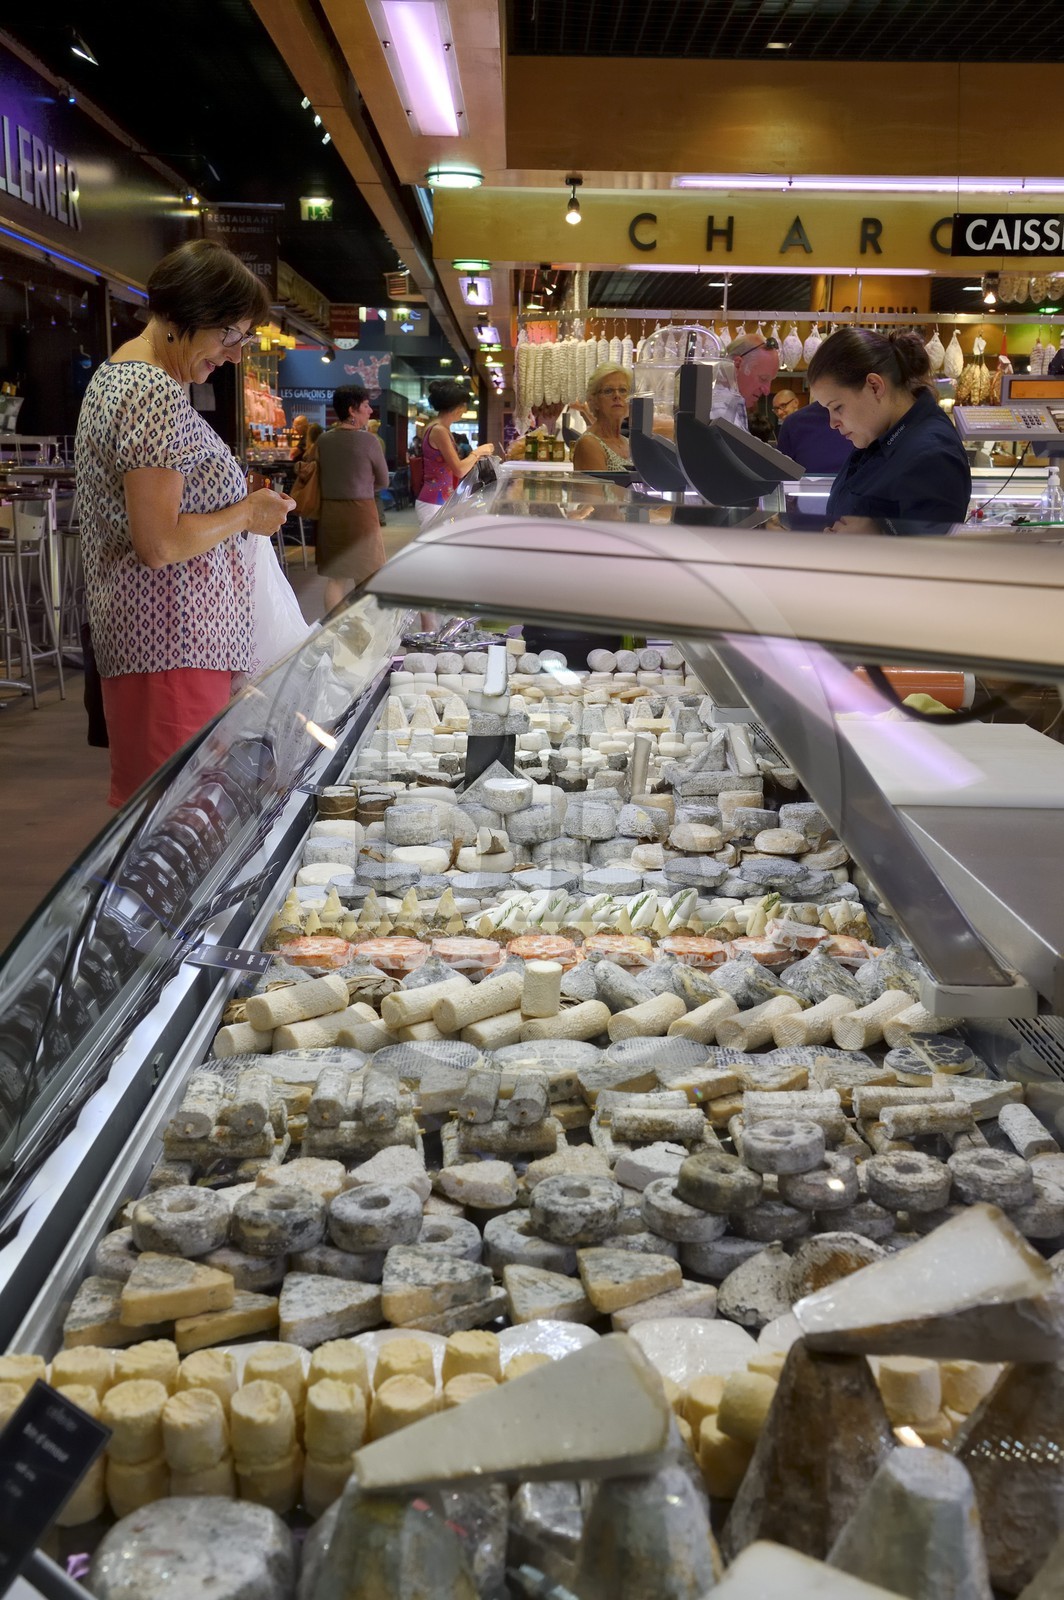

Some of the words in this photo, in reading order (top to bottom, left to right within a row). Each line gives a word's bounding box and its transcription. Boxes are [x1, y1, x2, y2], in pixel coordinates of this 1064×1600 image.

[207, 214, 274, 224] RESTAURANT
[965, 219, 1064, 251] CAISS
[281, 389, 293, 398] LES
